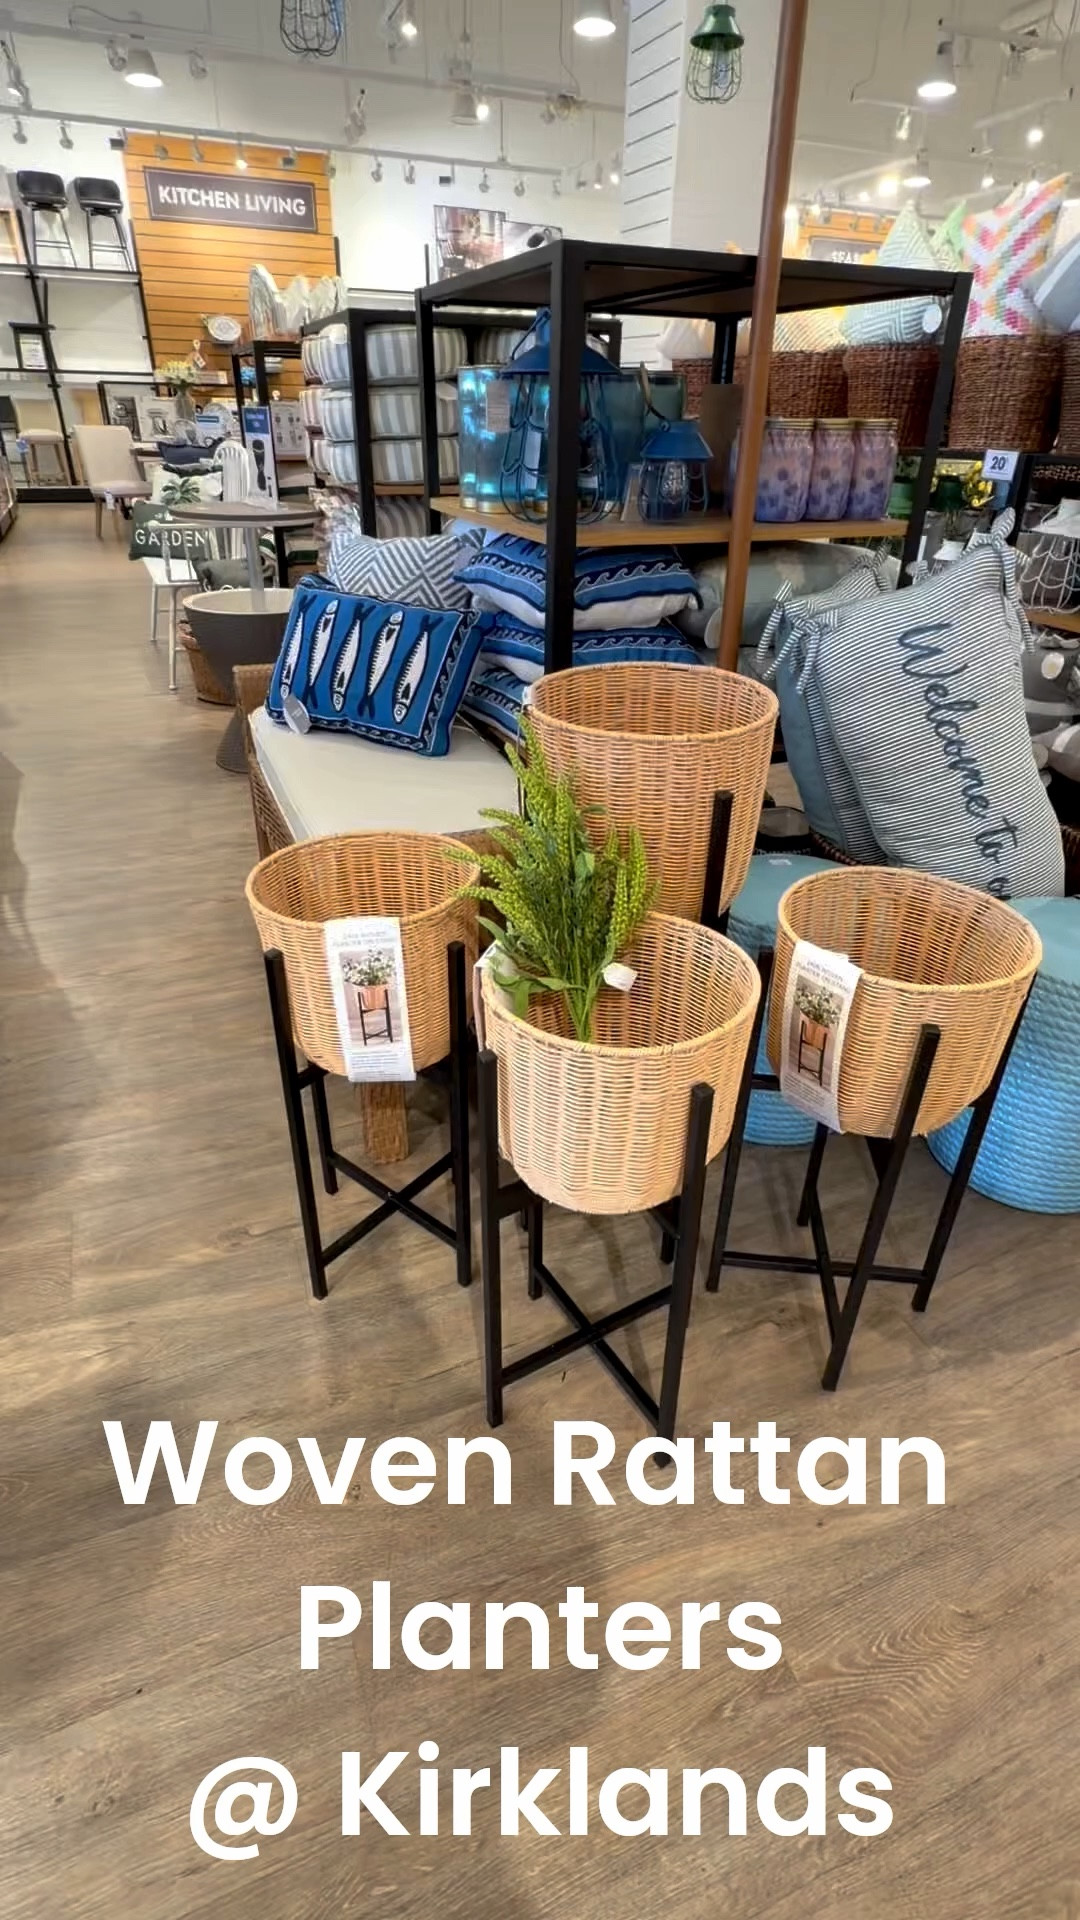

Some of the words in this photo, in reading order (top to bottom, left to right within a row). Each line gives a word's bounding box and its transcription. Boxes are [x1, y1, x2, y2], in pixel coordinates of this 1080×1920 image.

[157, 185, 240, 210] KITCHEN
[245, 193, 306, 216] LIVING
[990, 455, 1006, 471] 20
[135, 529, 209, 547] GARDEN
[898, 622, 989, 820] Welcome
[975, 816, 1019, 864] to
